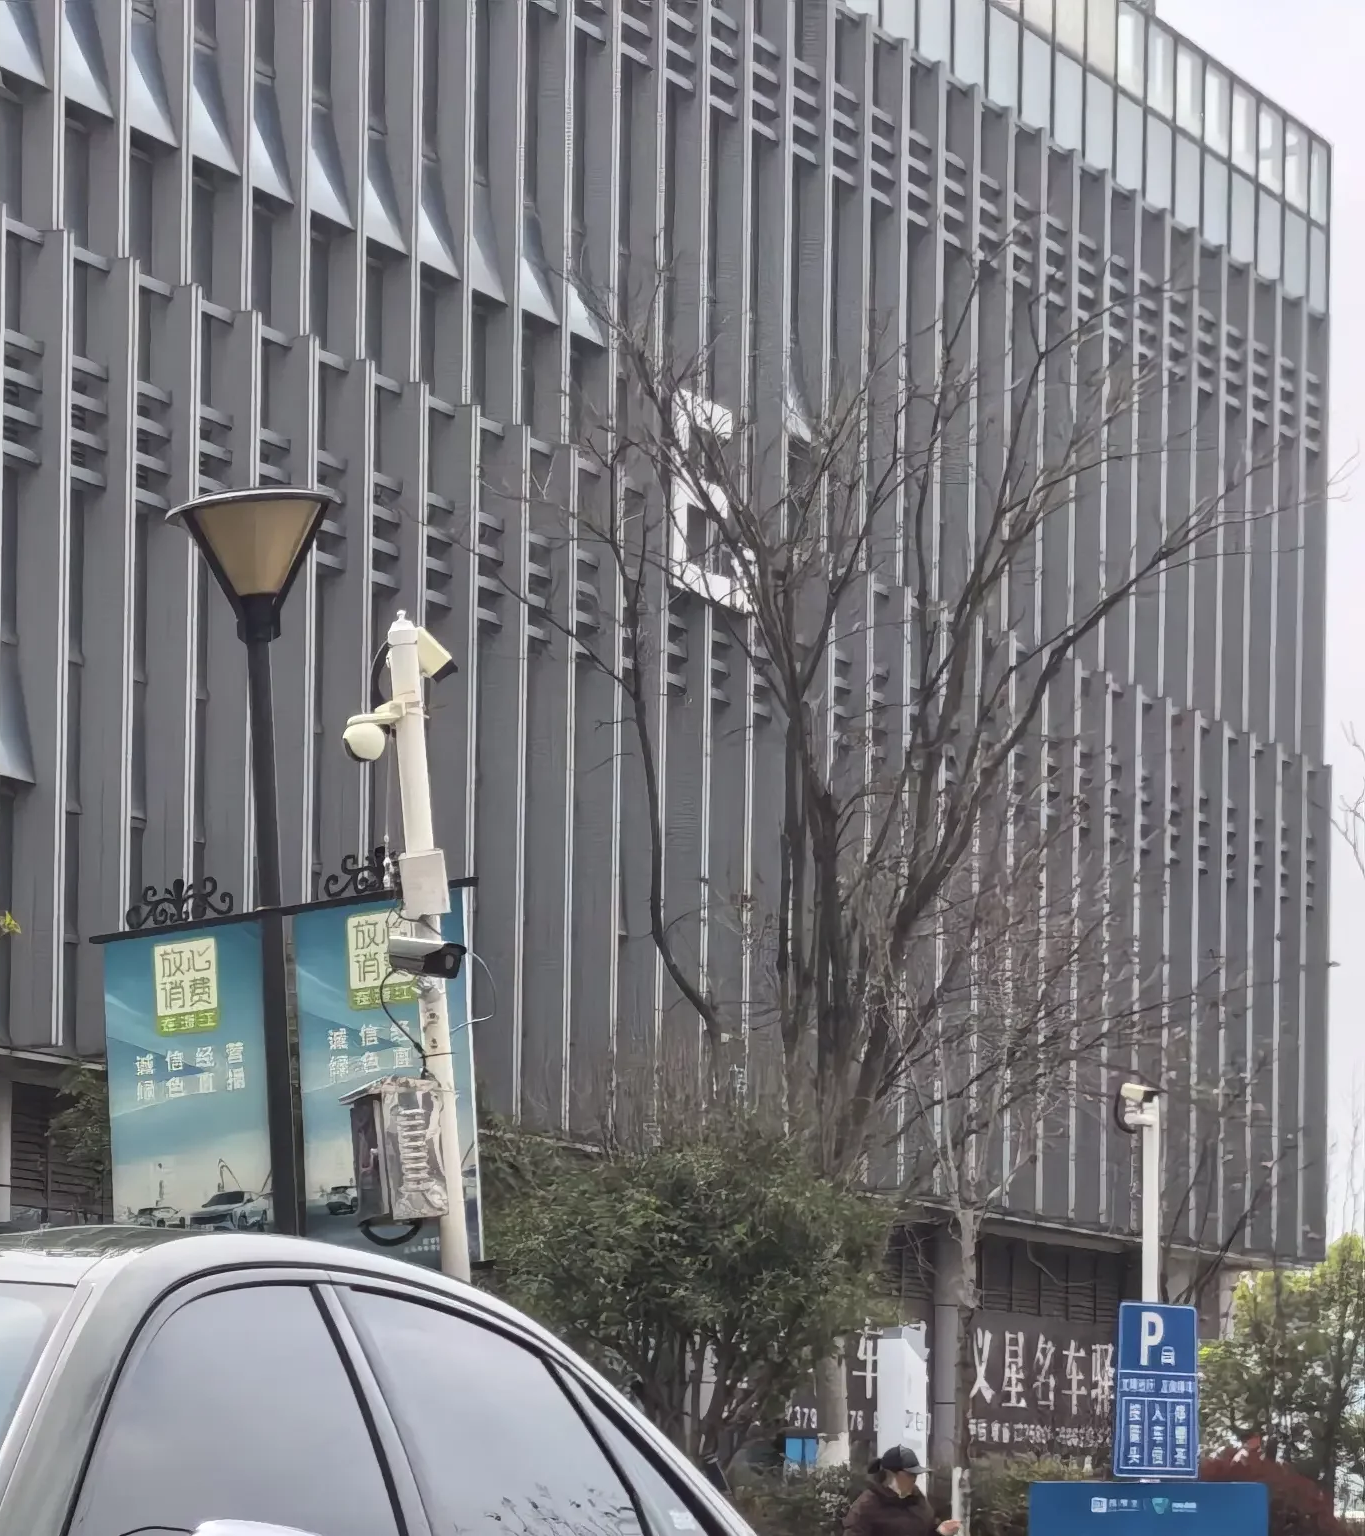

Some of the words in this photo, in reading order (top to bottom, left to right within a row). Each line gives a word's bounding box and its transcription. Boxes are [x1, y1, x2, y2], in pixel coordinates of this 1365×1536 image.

[160, 945, 212, 978] 放心
[161, 977, 212, 1010] 消费
[327, 1020, 411, 1050] 诚信经
[1140, 1311, 1164, 1366] P
